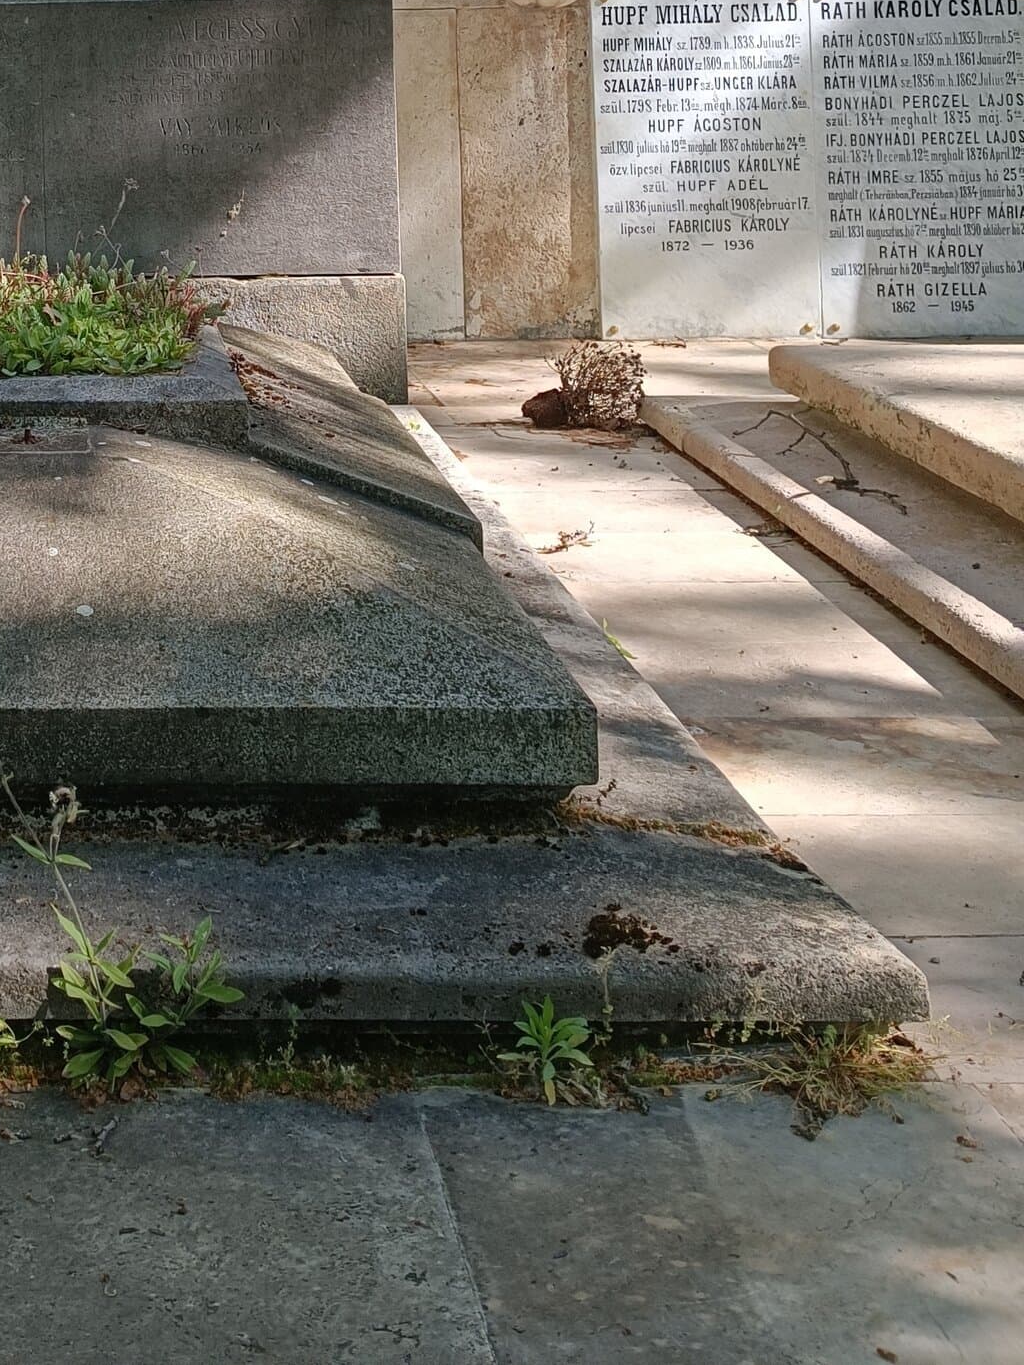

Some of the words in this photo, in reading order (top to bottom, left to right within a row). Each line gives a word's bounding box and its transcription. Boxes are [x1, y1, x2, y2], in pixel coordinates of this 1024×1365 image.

[602, 6, 648, 25] HUPF
[603, 38, 630, 52] HUPF
[634, 32, 672, 50] MIHÁLY
[823, 31, 852, 48] RÁTH
[858, 30, 914, 48] ÁGOSTON
[603, 55, 652, 72] SZALAZÁR
[657, 54, 695, 71] KÁROLY
[824, 51, 853, 69] RÁTH
[859, 50, 897, 68] MÁRIA
[605, 75, 699, 93] SZALAZÁR-HUPF
[714, 76, 753, 90] UNGER
[758, 72, 797, 89] KLÁRA
[824, 71, 855, 89] RÁTH
[860, 76, 897, 88] VILMA
[825, 91, 893, 110] BONYHÁDI
[903, 95, 969, 109] PERCZEL
[979, 93, 1024, 107] LAJOS
[648, 119, 685, 133] HUPF
[694, 114, 762, 132] ÁGOSTON
[850, 127, 915, 146] BONYHÁDI
[922, 131, 980, 145] PERCZEL
[986, 130, 1024, 144] LAJOS
[670, 160, 730, 174] FABRICIUS
[738, 154, 800, 172] KÁROLYNÉ
[677, 180, 717, 192] HUPF
[727, 175, 768, 190] ADÉL
[828, 167, 860, 184] RÁTH
[867, 170, 899, 184] IMRE
[830, 205, 862, 222] RÁTH
[869, 202, 937, 221] KÁROLYNÉ
[951, 206, 981, 220] HUPF
[669, 219, 731, 233] FABRICIUS
[741, 213, 789, 232] KÁROLY
[662, 241, 690, 251] 1872
[725, 239, 754, 250] 1936
[879, 242, 917, 258] RÁTH
[928, 241, 983, 258] KÁROLY
[877, 278, 915, 297] RÁTH
[926, 283, 987, 296] GIZELLA
[892, 301, 916, 313] 1862
